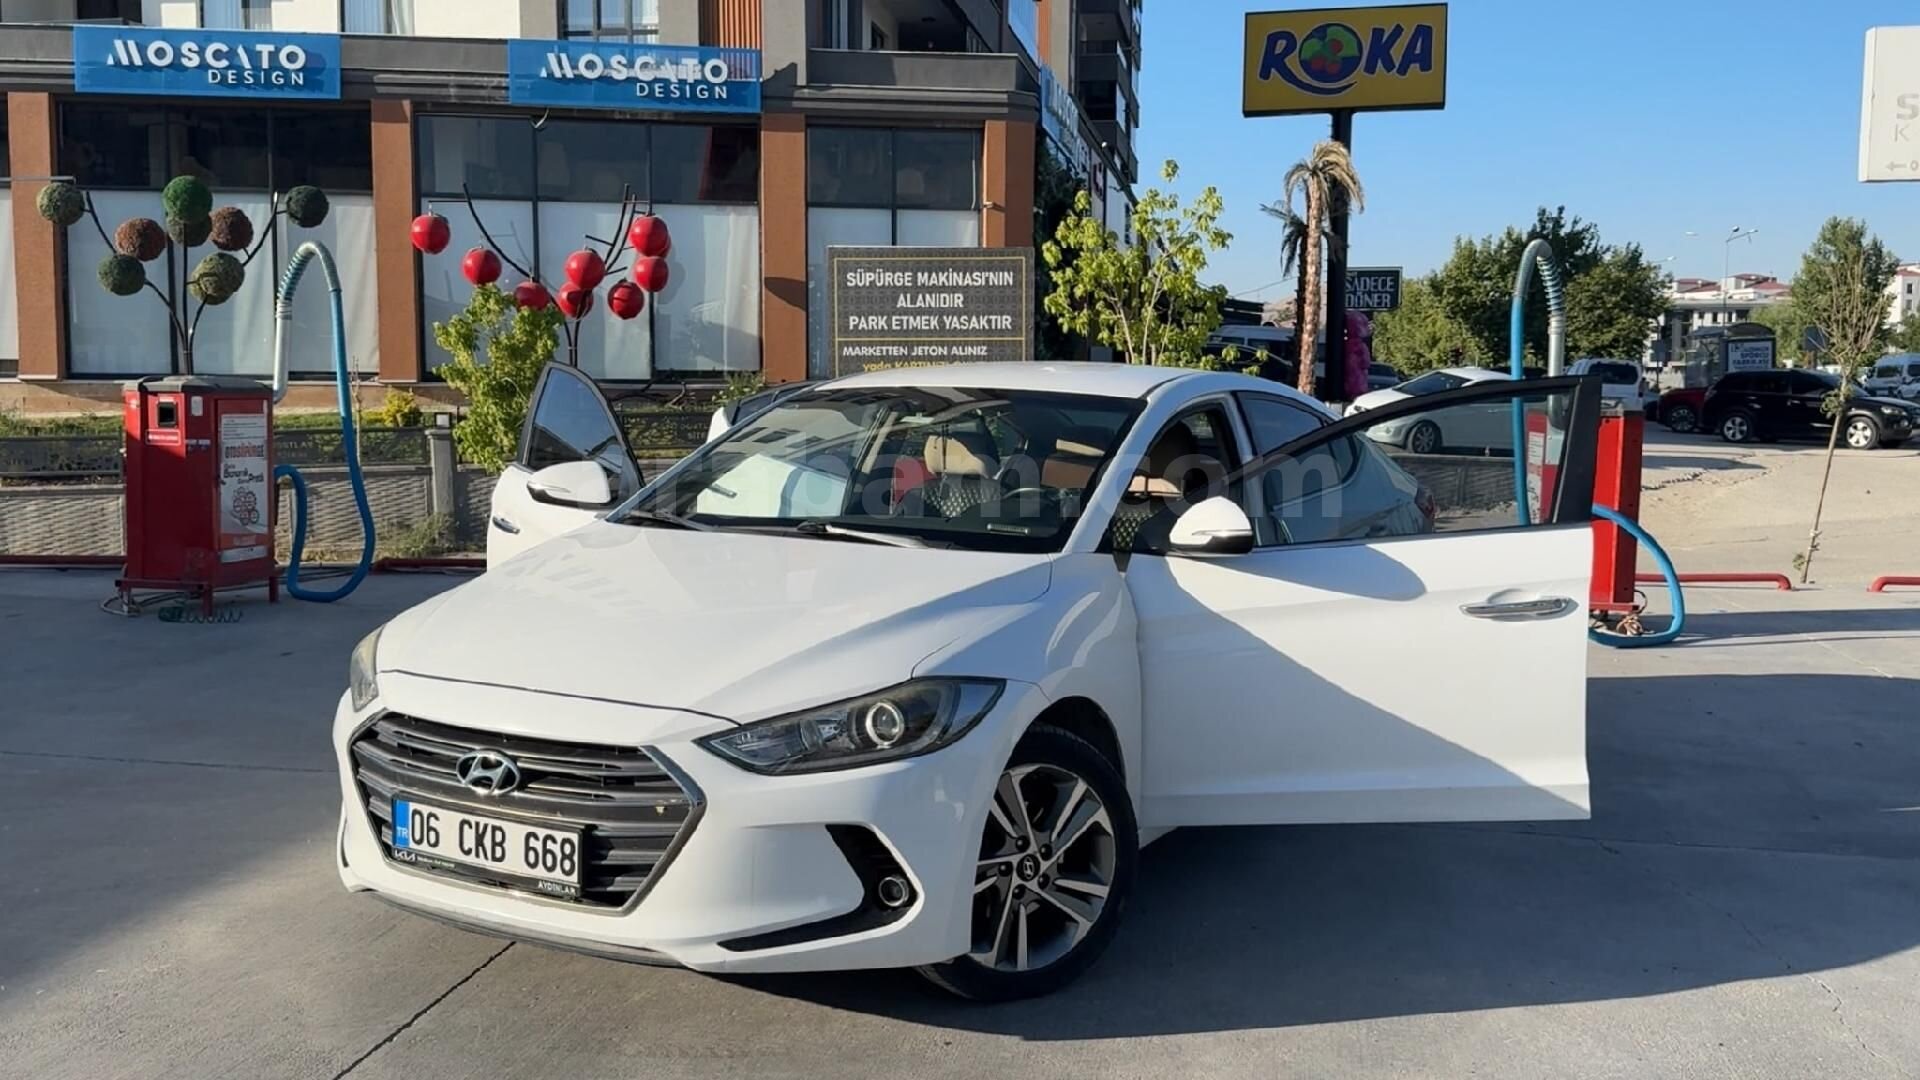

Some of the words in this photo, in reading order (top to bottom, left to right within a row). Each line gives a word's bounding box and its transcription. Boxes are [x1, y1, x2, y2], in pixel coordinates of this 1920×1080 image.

[106, 39, 307, 70] MOSCATO
[1258, 23, 1434, 95] ROKA
[539, 52, 729, 84] MOSCATO
[208, 69, 304, 85] DESIGN
[636, 82, 728, 99] DESIGN
[846, 268, 912, 287] SÜPÜRGE
[917, 268, 1014, 286] MAKİNASI'NIN
[896, 293, 964, 308] ALANIDIR
[849, 315, 888, 331] PARK
[891, 315, 939, 330] ETMEK
[943, 315, 1012, 330] YASAKTIR
[842, 346, 908, 356] MARKETTEN
[911, 345, 948, 356] JETON
[950, 345, 988, 356] ALINIZ
[396, 825, 409, 838] TR
[411, 808, 440, 848] 06
[458, 818, 507, 863] CKB
[523, 831, 577, 877] 668
